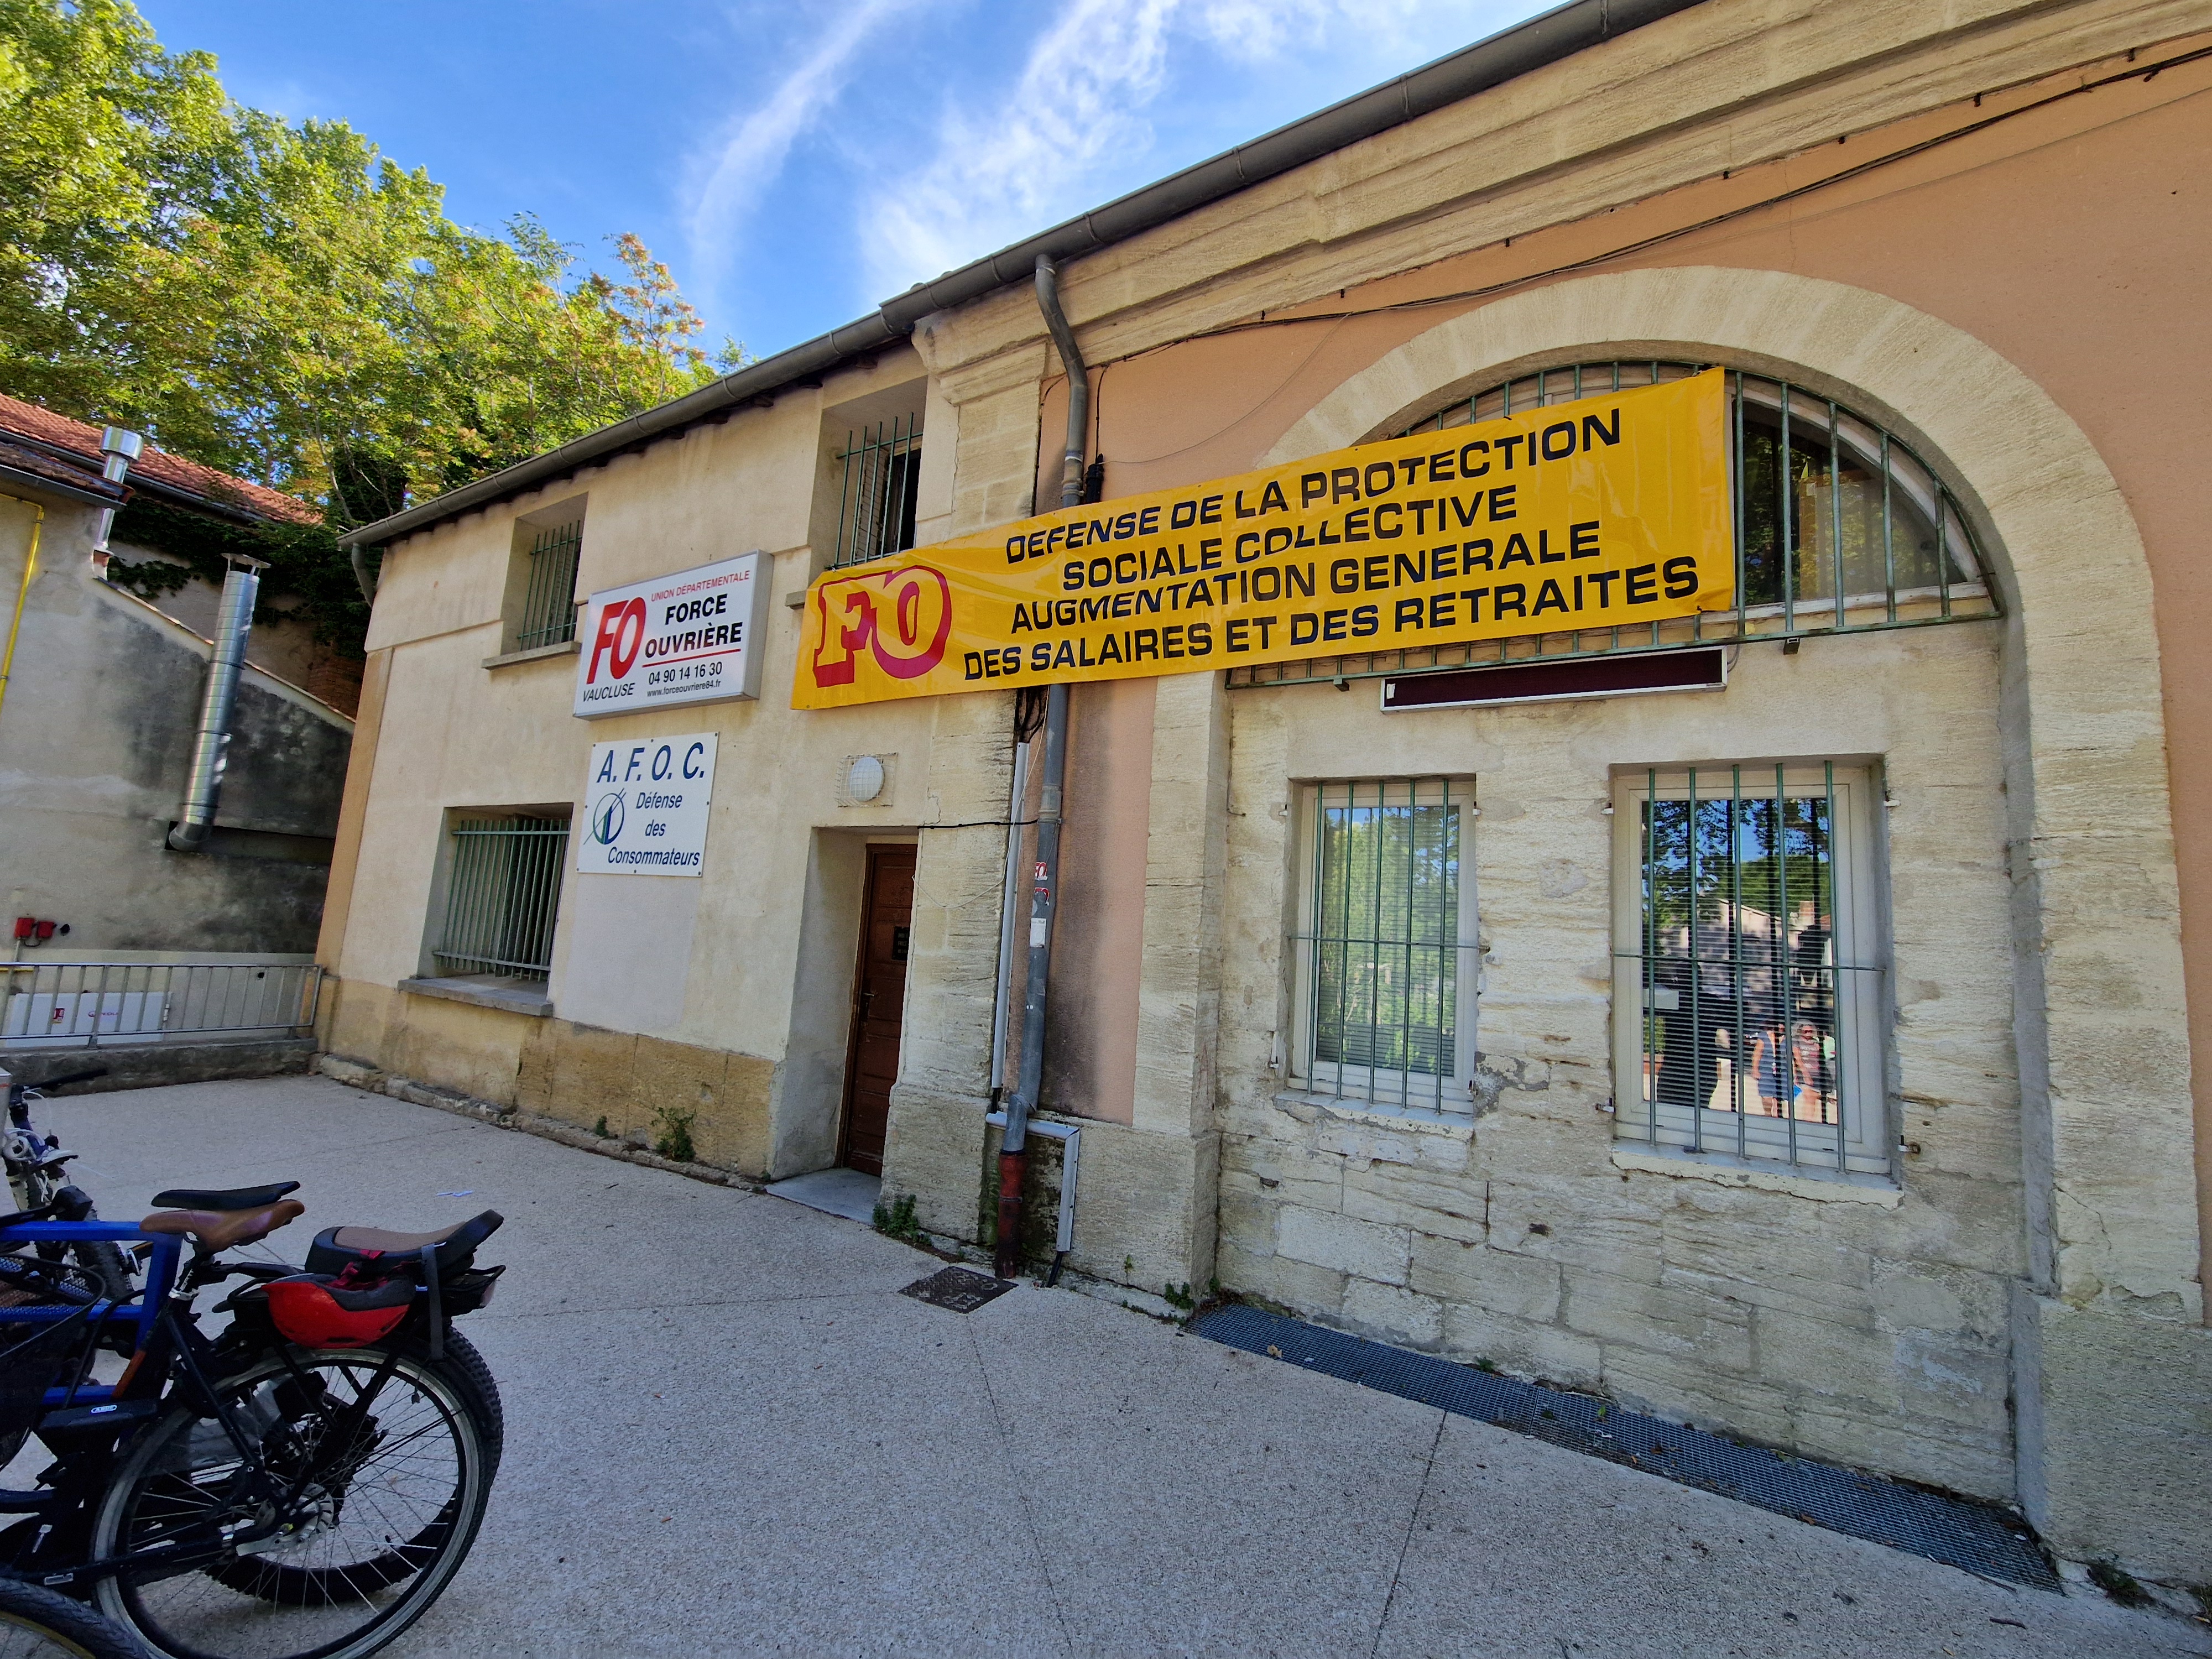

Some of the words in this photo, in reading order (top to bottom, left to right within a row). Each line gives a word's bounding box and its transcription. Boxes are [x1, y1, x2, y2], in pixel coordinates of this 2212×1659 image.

[1005, 505, 1161, 565] DEFENSE
[1171, 494, 1223, 530] DE
[1234, 481, 1290, 518] LA
[1301, 408, 1621, 508] PROTECTION
[1062, 538, 1223, 591] SOCIALE
[1235, 484, 1517, 565] COLLECTIVE
[651, 590, 674, 602] UNION
[676, 570, 750, 596] DÉPARTEMENTALE
[1011, 562, 1316, 634] AUGMENTATION
[1329, 520, 1600, 594] GENERALE
[665, 593, 728, 625] FORCE
[964, 646, 1021, 681] DES
[1031, 623, 1212, 671] SALAIRES
[1226, 617, 1270, 653] ET
[1290, 604, 1379, 646] DES
[1395, 556, 1699, 633] RETRAITES
[586, 597, 646, 685] FO
[645, 622, 743, 658] OUVRIÈRE
[813, 565, 951, 688] FO
[646, 680, 721, 697] www.forceouvriere84.fr
[648, 671, 660, 685] 04
[663, 669, 675, 683] 90
[679, 666, 691, 680] 14
[694, 663, 706, 678] 16
[709, 661, 722, 676] 30
[582, 682, 635, 702] VAUCLUSE
[635, 791, 683, 809] Défense
[645, 819, 666, 837] des
[608, 846, 701, 866] Consommateurs
